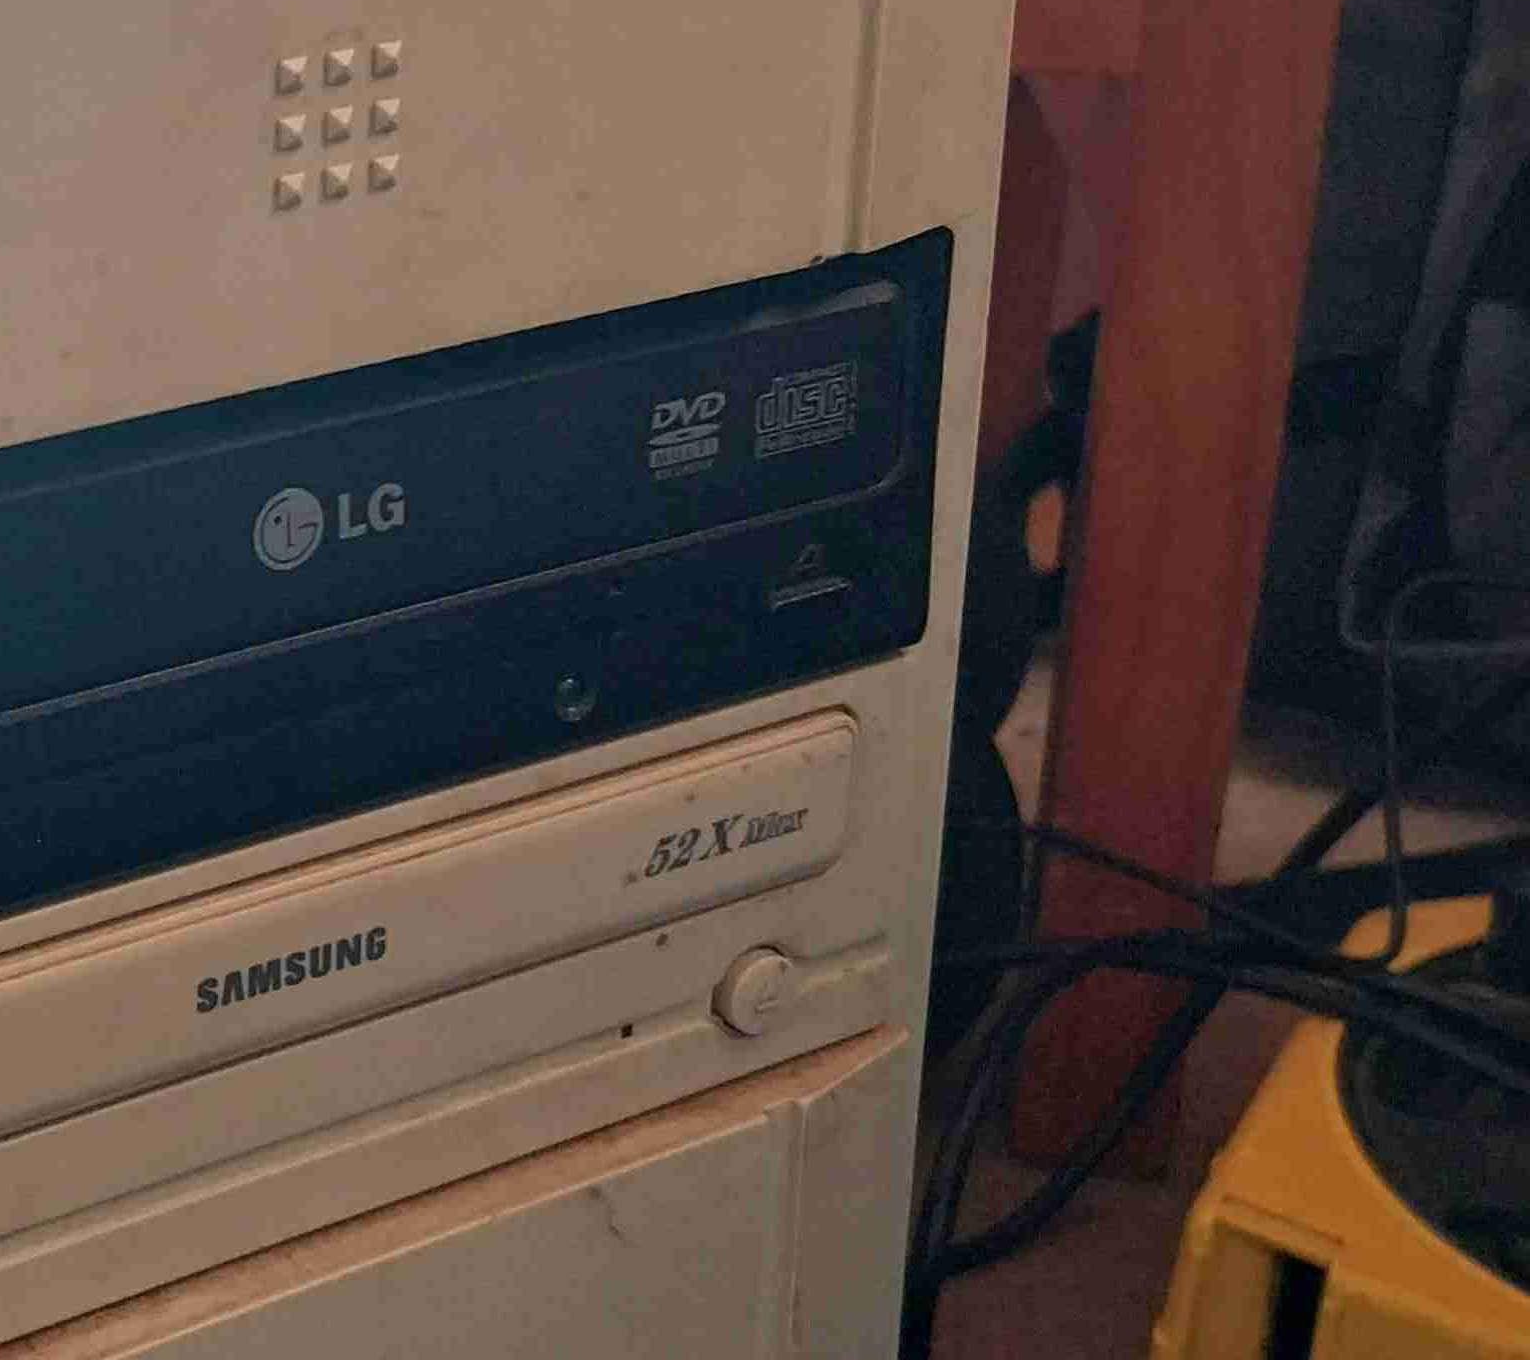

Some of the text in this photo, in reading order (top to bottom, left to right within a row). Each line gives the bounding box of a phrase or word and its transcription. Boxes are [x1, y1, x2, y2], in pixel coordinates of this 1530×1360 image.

[651, 391, 727, 430] DVD
[337, 482, 406, 539] LG
[196, 926, 387, 1014] SAMSUNG
